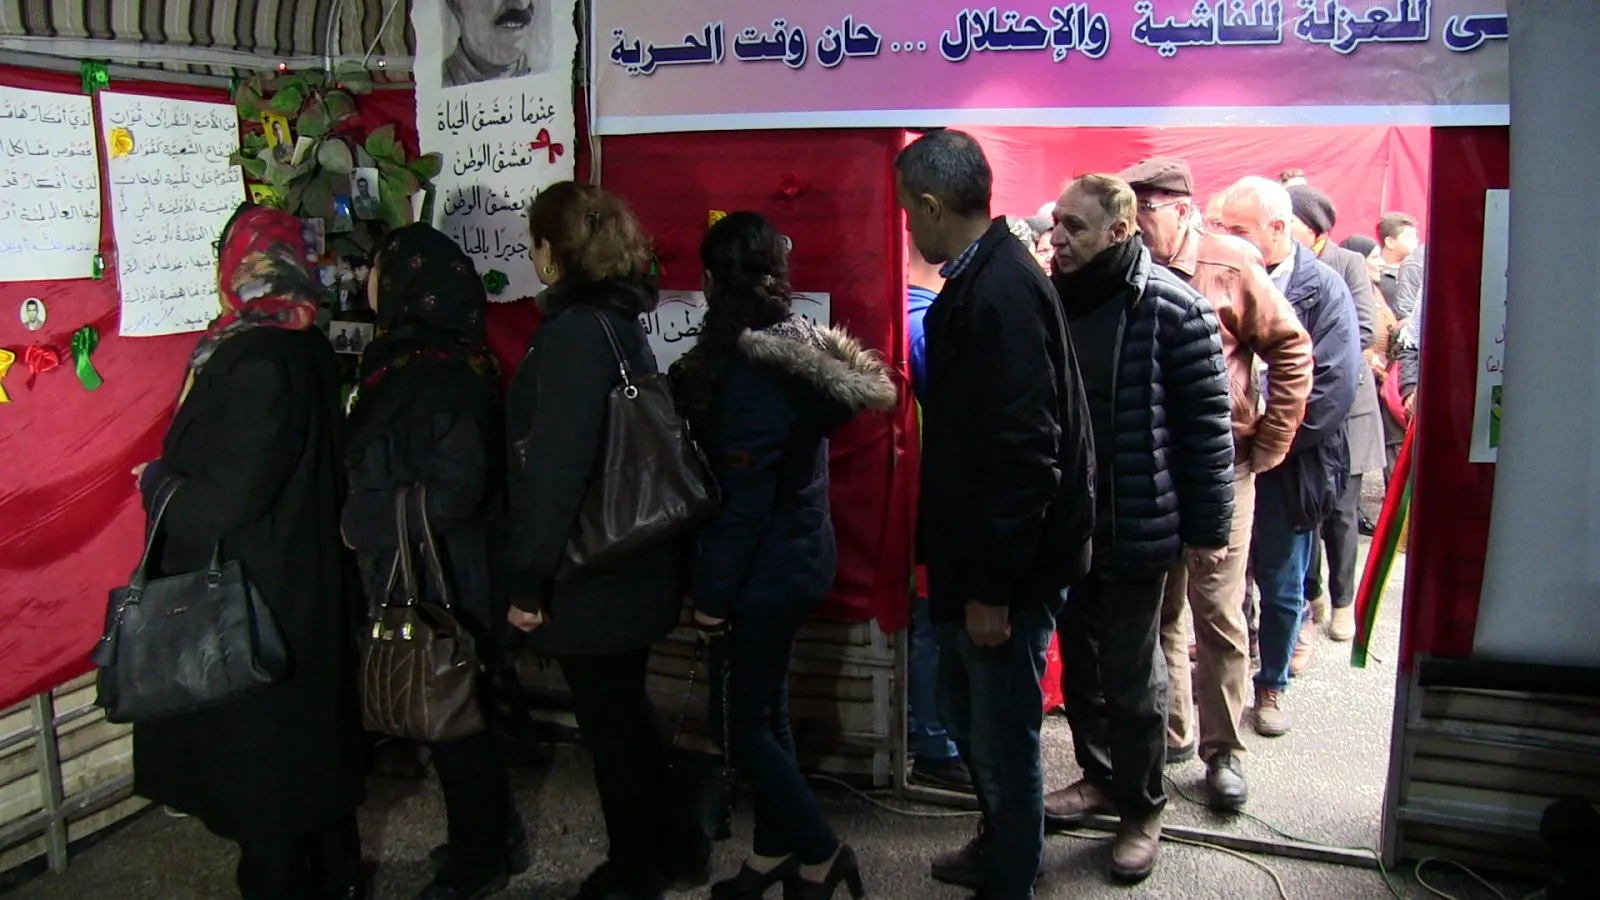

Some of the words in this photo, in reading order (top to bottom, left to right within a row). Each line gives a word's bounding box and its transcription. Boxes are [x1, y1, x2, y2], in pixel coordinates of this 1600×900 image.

[609, 21, 724, 76] الحرية
[732, 17, 808, 69] وقت
[816, 15, 882, 68] حان
[1131, 0, 1283, 57] للفاشية
